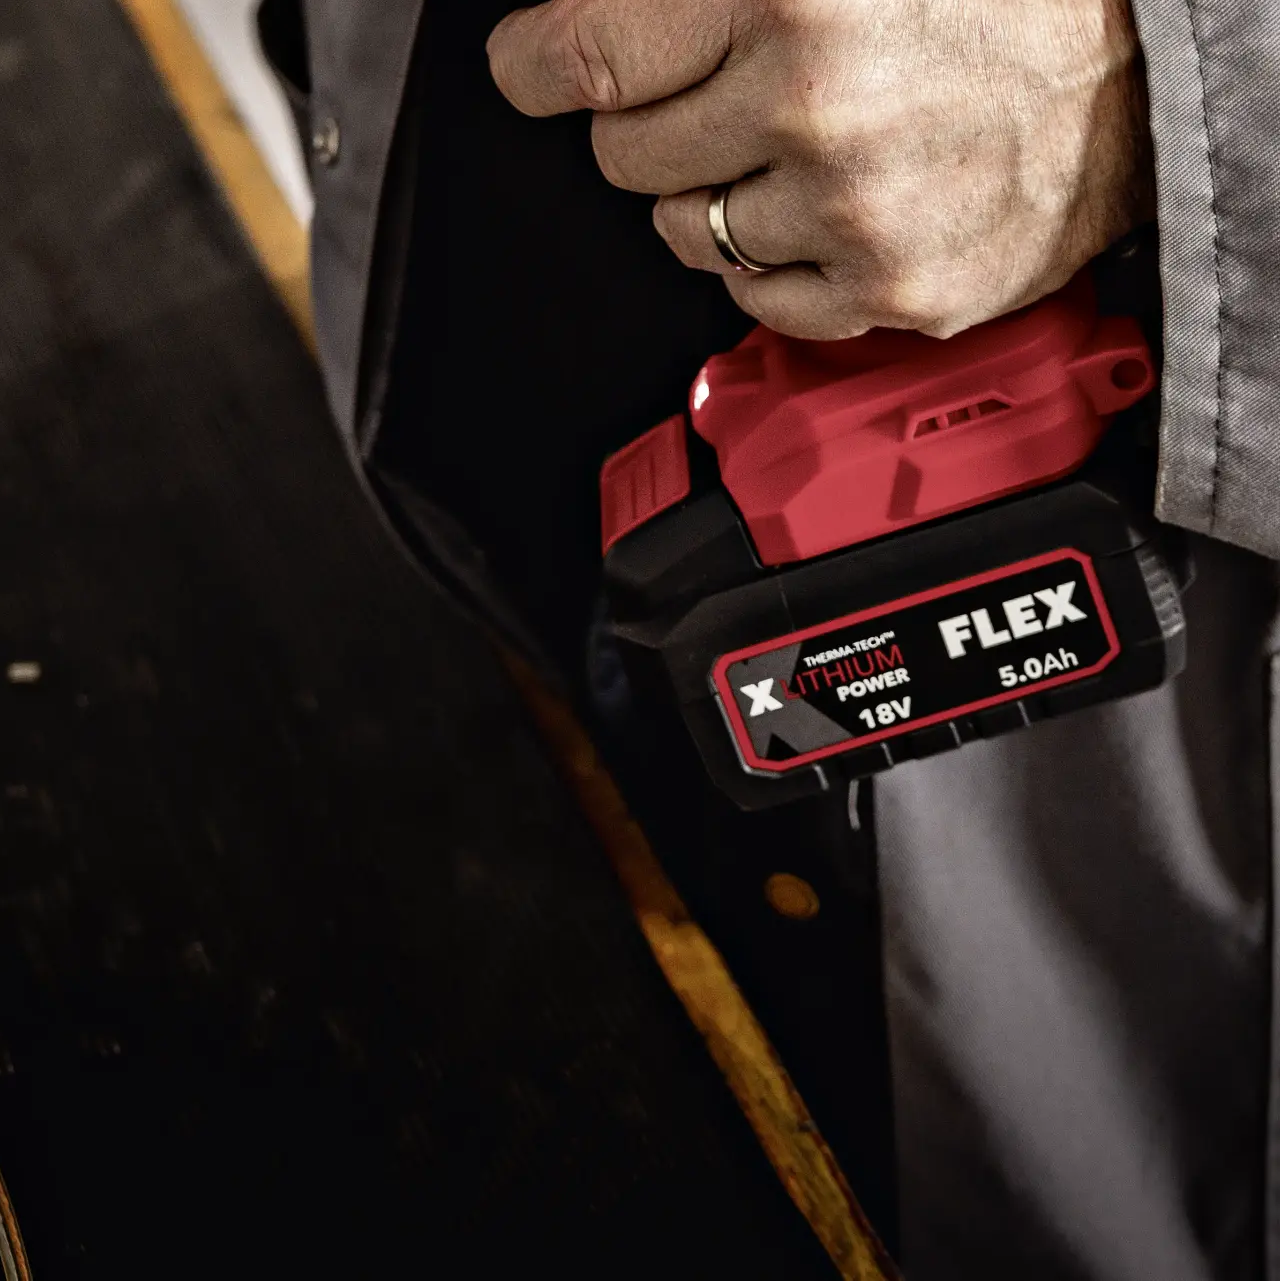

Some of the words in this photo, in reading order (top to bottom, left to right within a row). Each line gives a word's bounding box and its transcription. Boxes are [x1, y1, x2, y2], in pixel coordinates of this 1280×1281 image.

[938, 580, 1088, 659] FLEX
[779, 644, 906, 701] LITHIUM
[836, 667, 911, 703] POWER
[998, 651, 1079, 687] 5.0Ah
[858, 695, 913, 730] 18V
